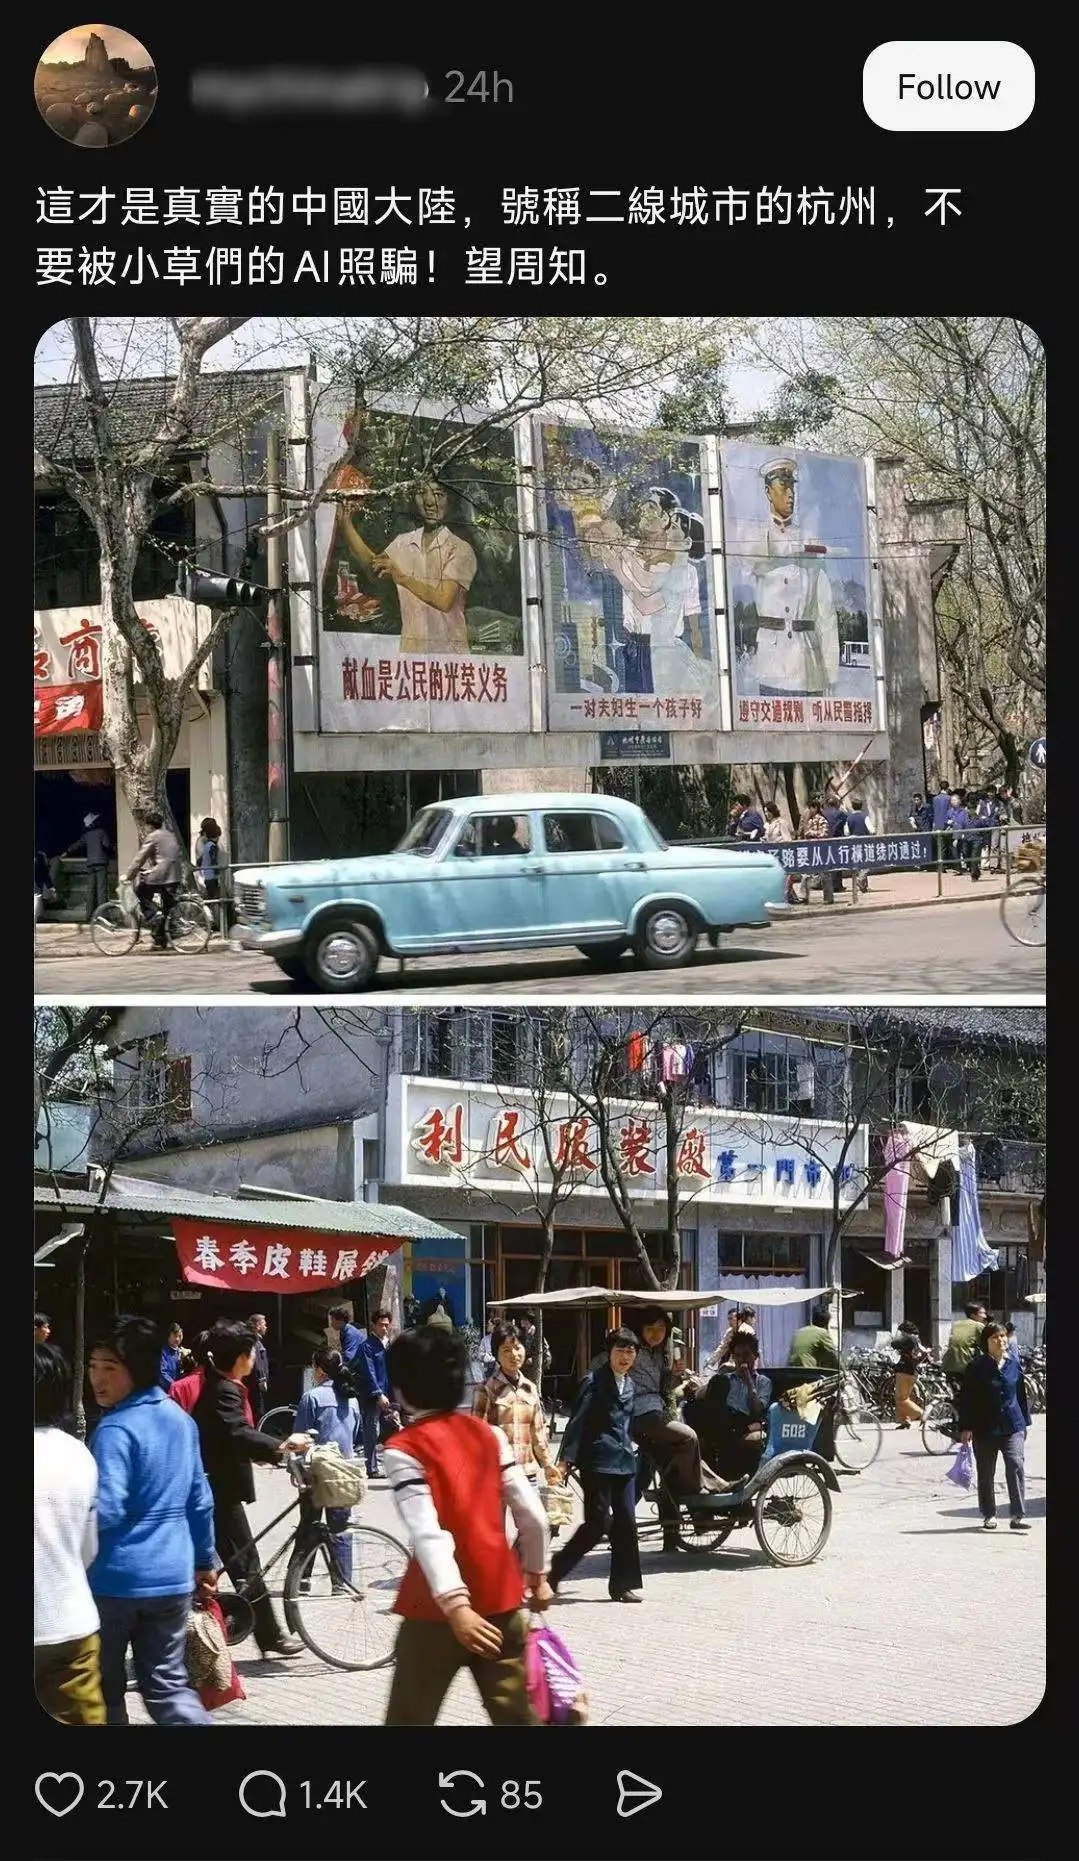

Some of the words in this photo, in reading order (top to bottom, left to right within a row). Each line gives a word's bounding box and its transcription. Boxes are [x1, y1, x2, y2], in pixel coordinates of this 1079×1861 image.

[342, 656, 508, 702] 献血是公民的光荣义务
[570, 697, 703, 719] 一对夫妇生一个孩子好
[739, 699, 804, 723] 遵守交通规则
[812, 700, 872, 723] 听从民警指挥
